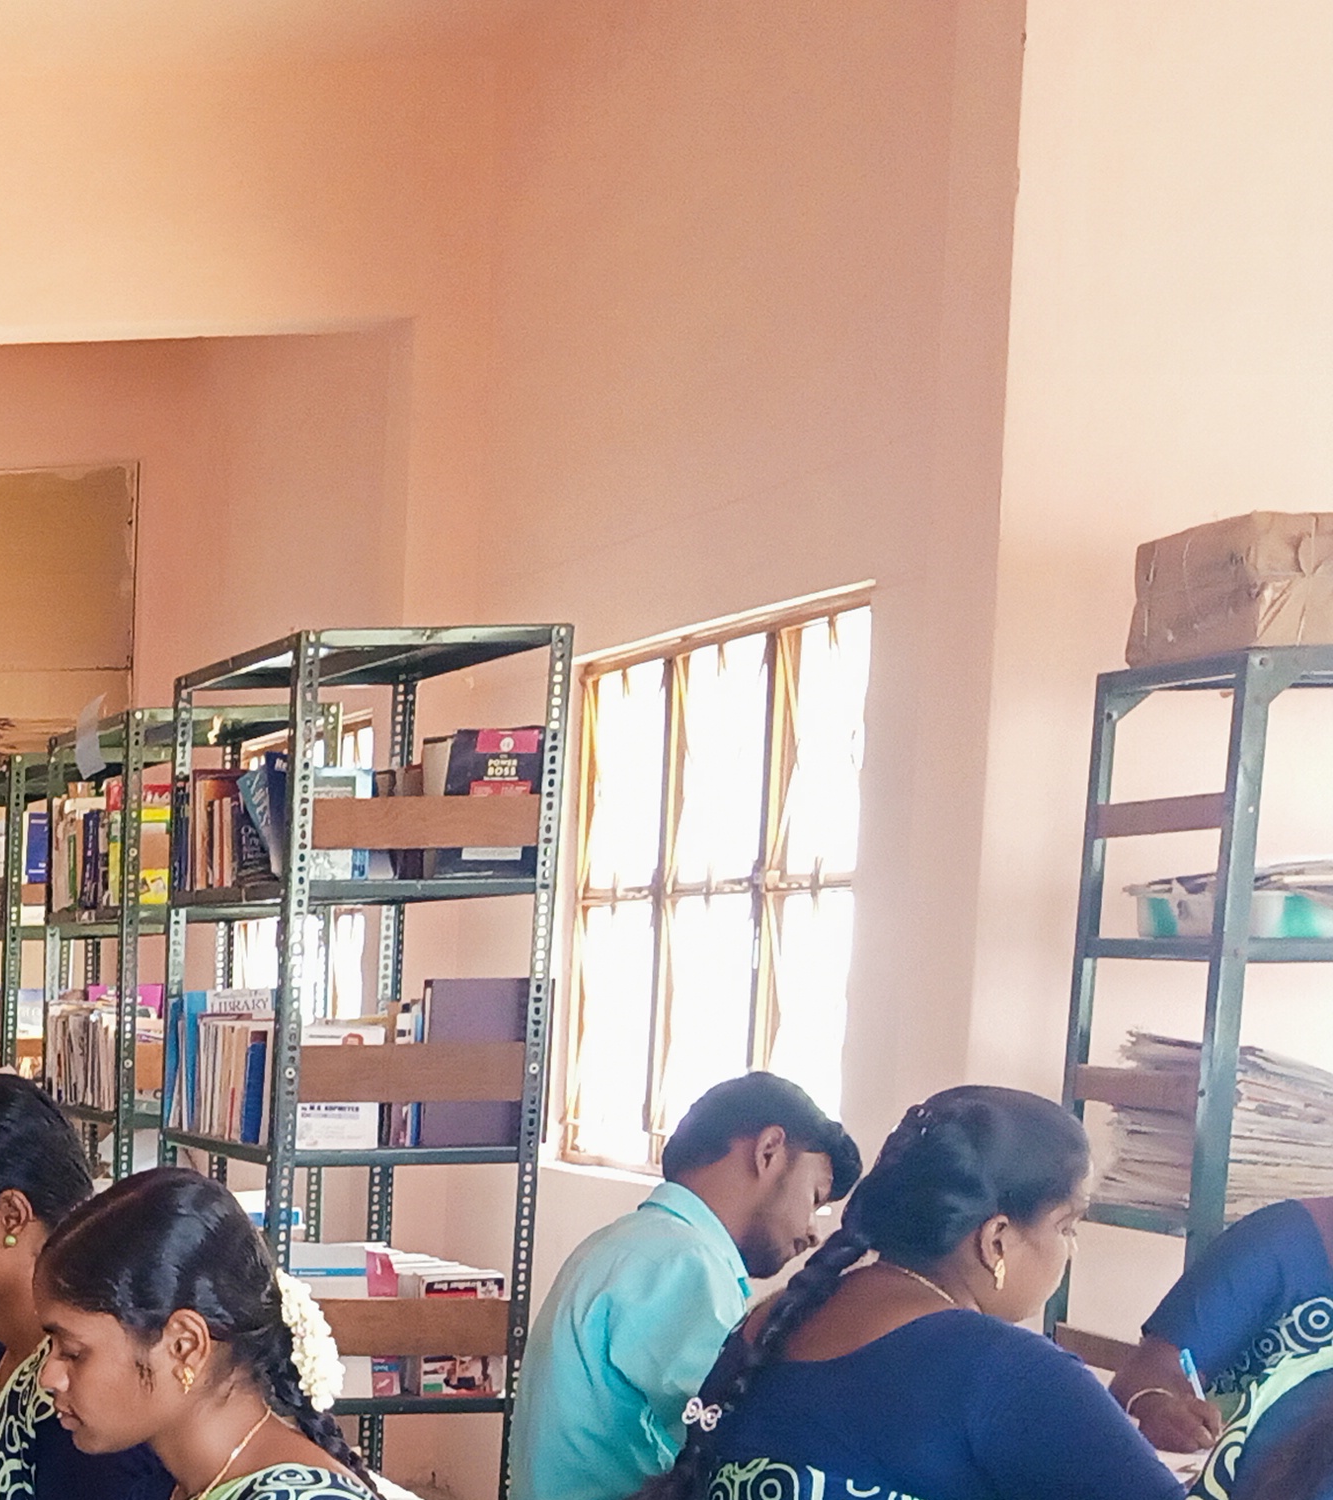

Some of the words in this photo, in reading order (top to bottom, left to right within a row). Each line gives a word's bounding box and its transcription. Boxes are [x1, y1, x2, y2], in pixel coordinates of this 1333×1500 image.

[487, 758, 518, 767] POWER
[487, 766, 517, 777] BOSS
[210, 997, 269, 1014] LIBRARY
